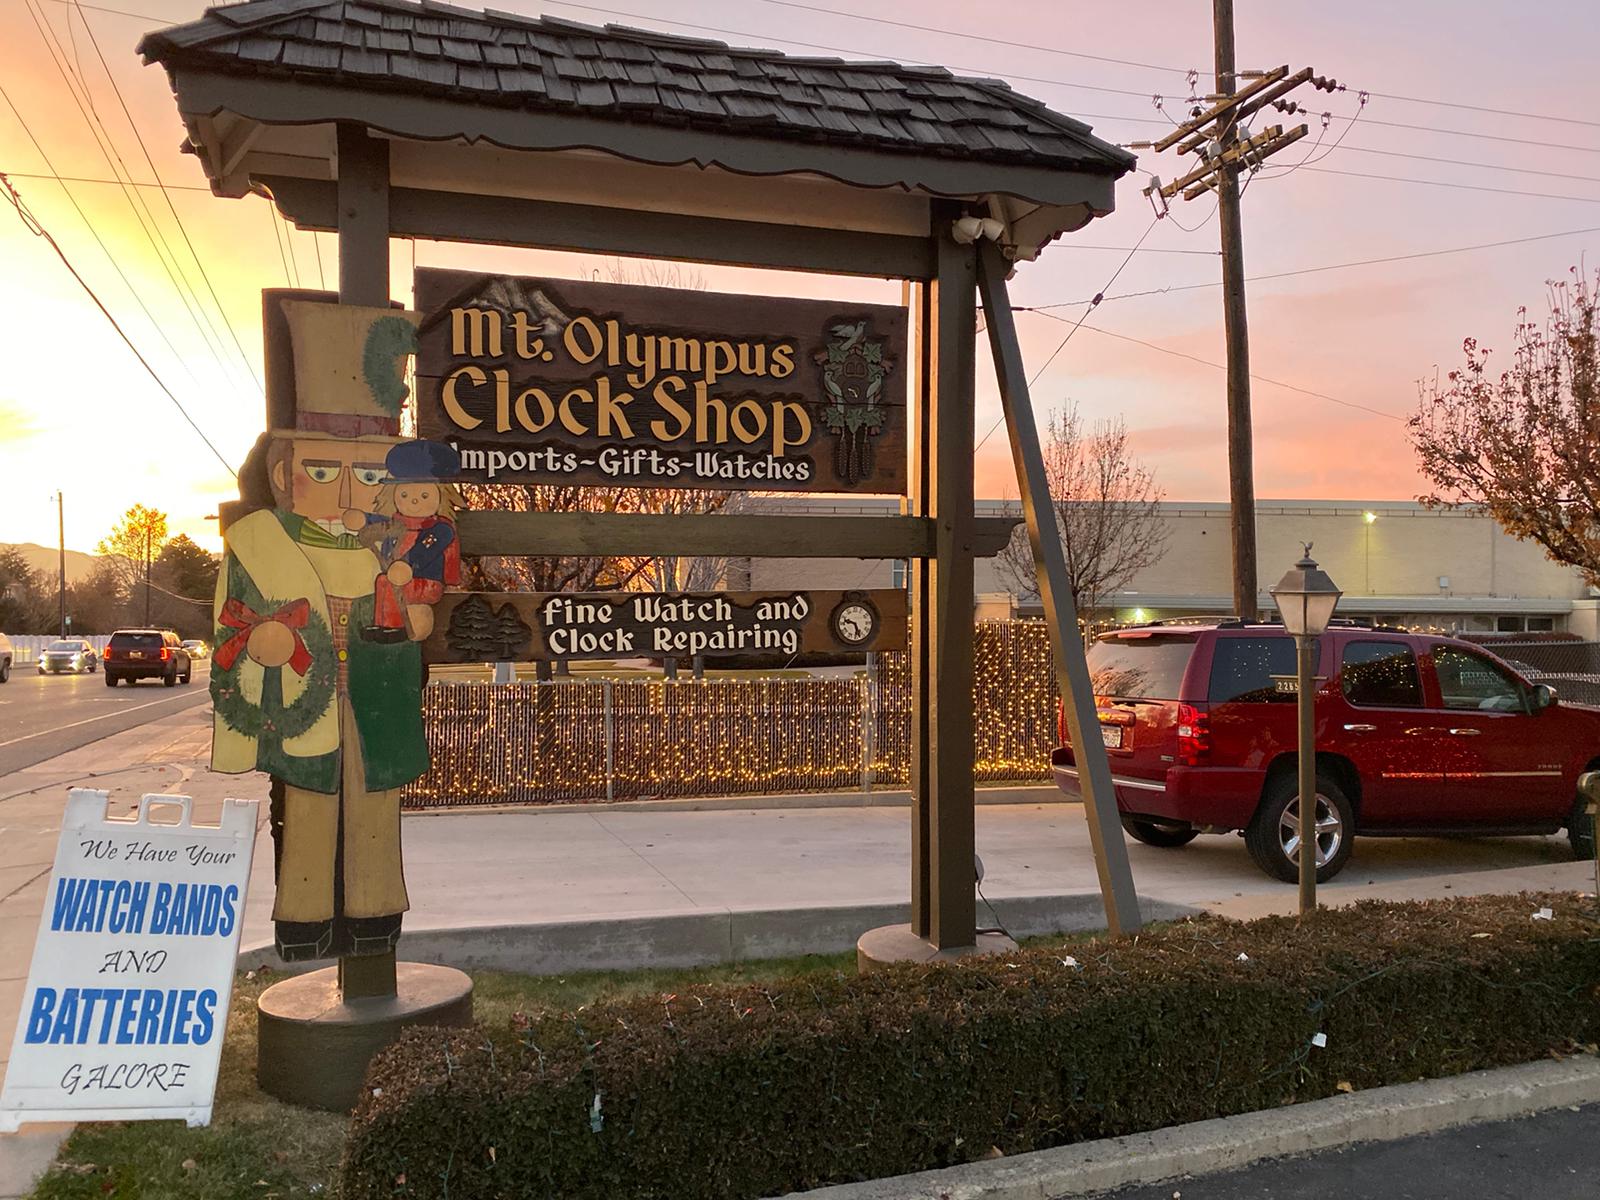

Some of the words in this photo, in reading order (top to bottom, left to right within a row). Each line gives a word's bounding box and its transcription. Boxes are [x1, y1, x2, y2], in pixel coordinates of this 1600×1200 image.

[450, 307, 553, 362] Mt.
[563, 316, 796, 389] Olympus
[441, 366, 636, 440] Clock
[650, 375, 813, 458] Shop
[635, 597, 732, 623] Watch
[757, 596, 809, 621] and
[548, 627, 634, 655] Clock
[653, 623, 798, 656] Repairing
[80, 839, 118, 860] We
[125, 842, 178, 864] Have
[185, 844, 237, 866] Your
[51, 877, 150, 935] WATCH
[150, 882, 239, 938] BANDS
[98, 950, 168, 974] AND
[24, 987, 218, 1045] BATTERIES
[60, 1063, 191, 1095] GALORE
